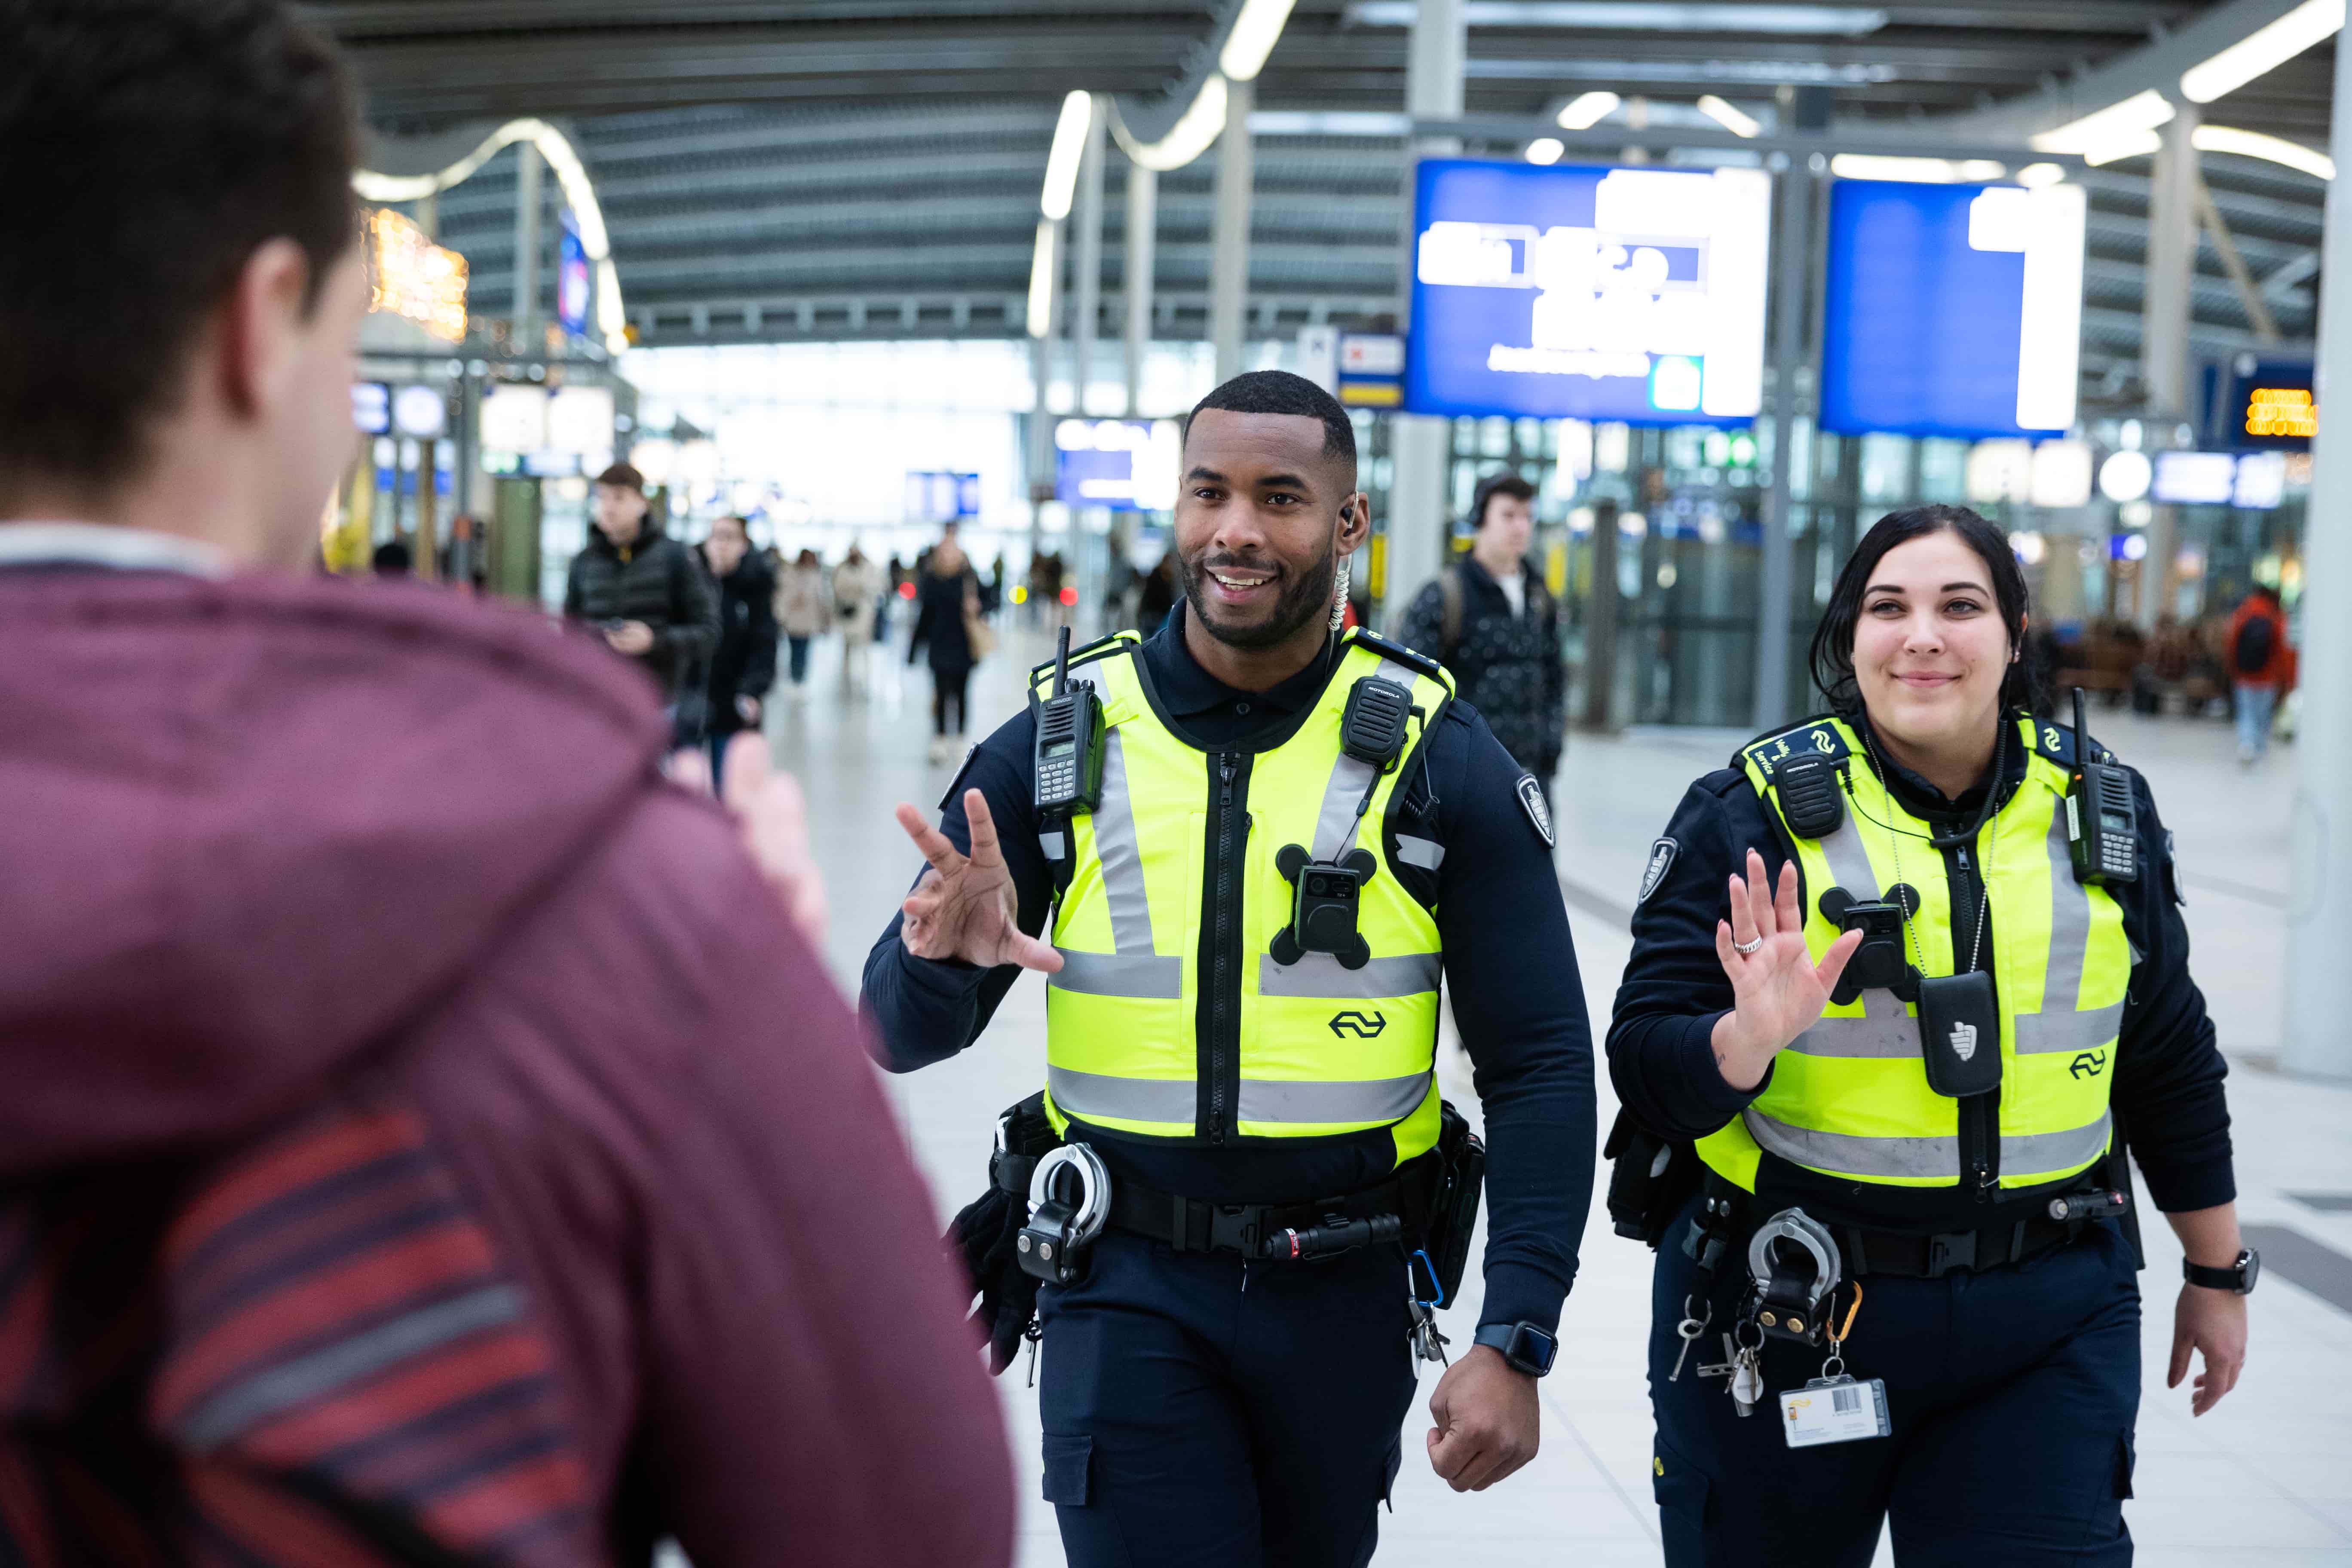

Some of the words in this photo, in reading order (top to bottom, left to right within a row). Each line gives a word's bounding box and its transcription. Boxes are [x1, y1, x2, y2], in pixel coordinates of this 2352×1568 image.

[1368, 686, 1400, 698] MOTOROLA
[1051, 697, 1072, 705] KENWOOD
[1755, 750, 1774, 775] Service
[1786, 762, 1819, 773] MOTOROLA
